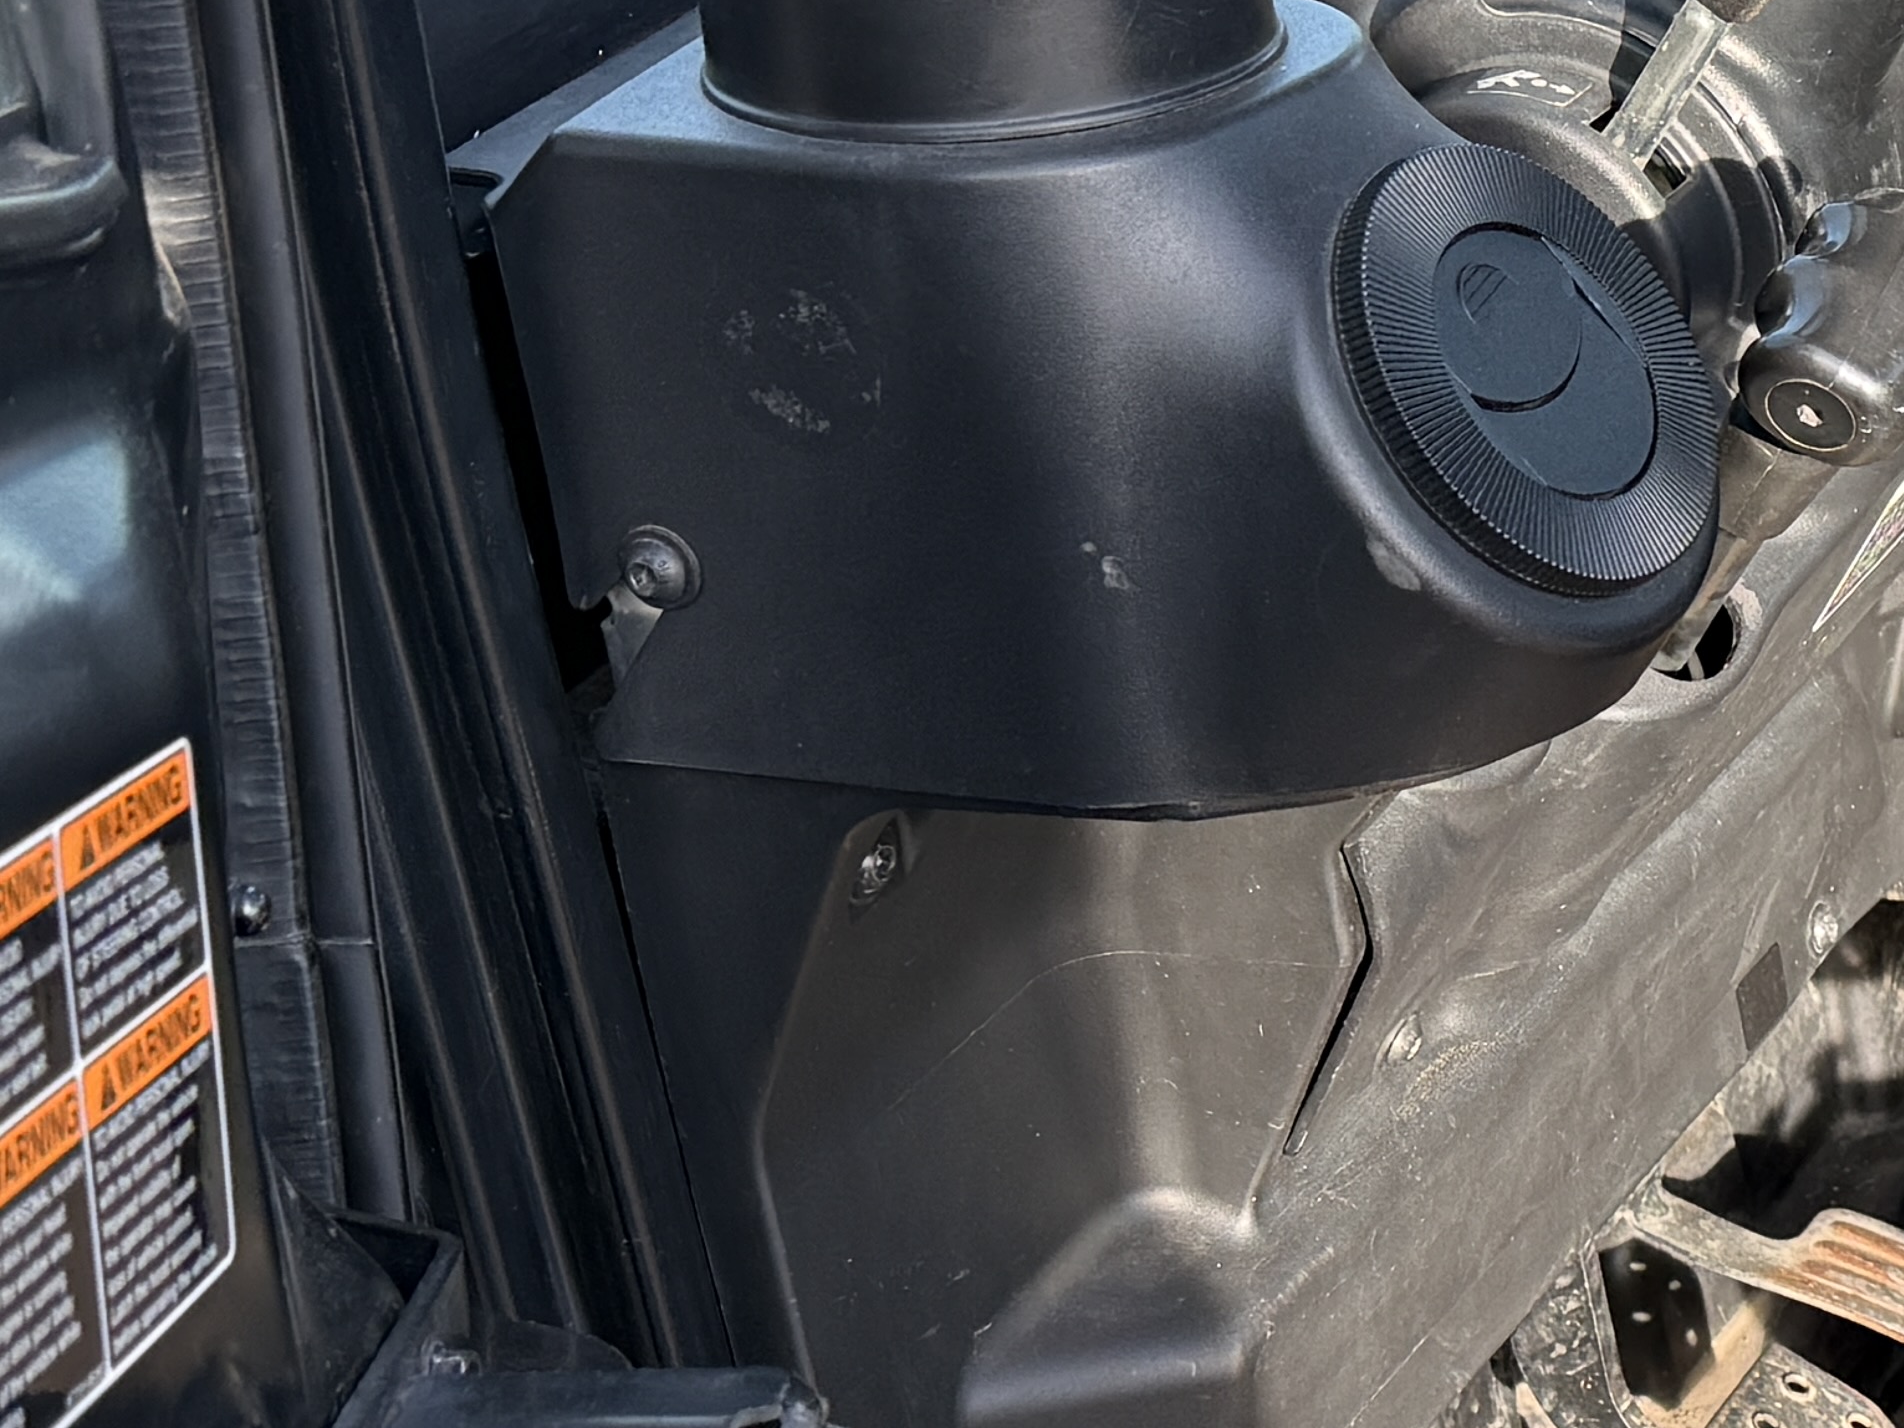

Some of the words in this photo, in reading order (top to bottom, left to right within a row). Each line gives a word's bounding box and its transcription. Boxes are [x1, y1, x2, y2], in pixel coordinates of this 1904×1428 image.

[97, 763, 183, 858] WARNING
[115, 993, 201, 1092] WARNING
[1, 1093, 79, 1188] ARNING
